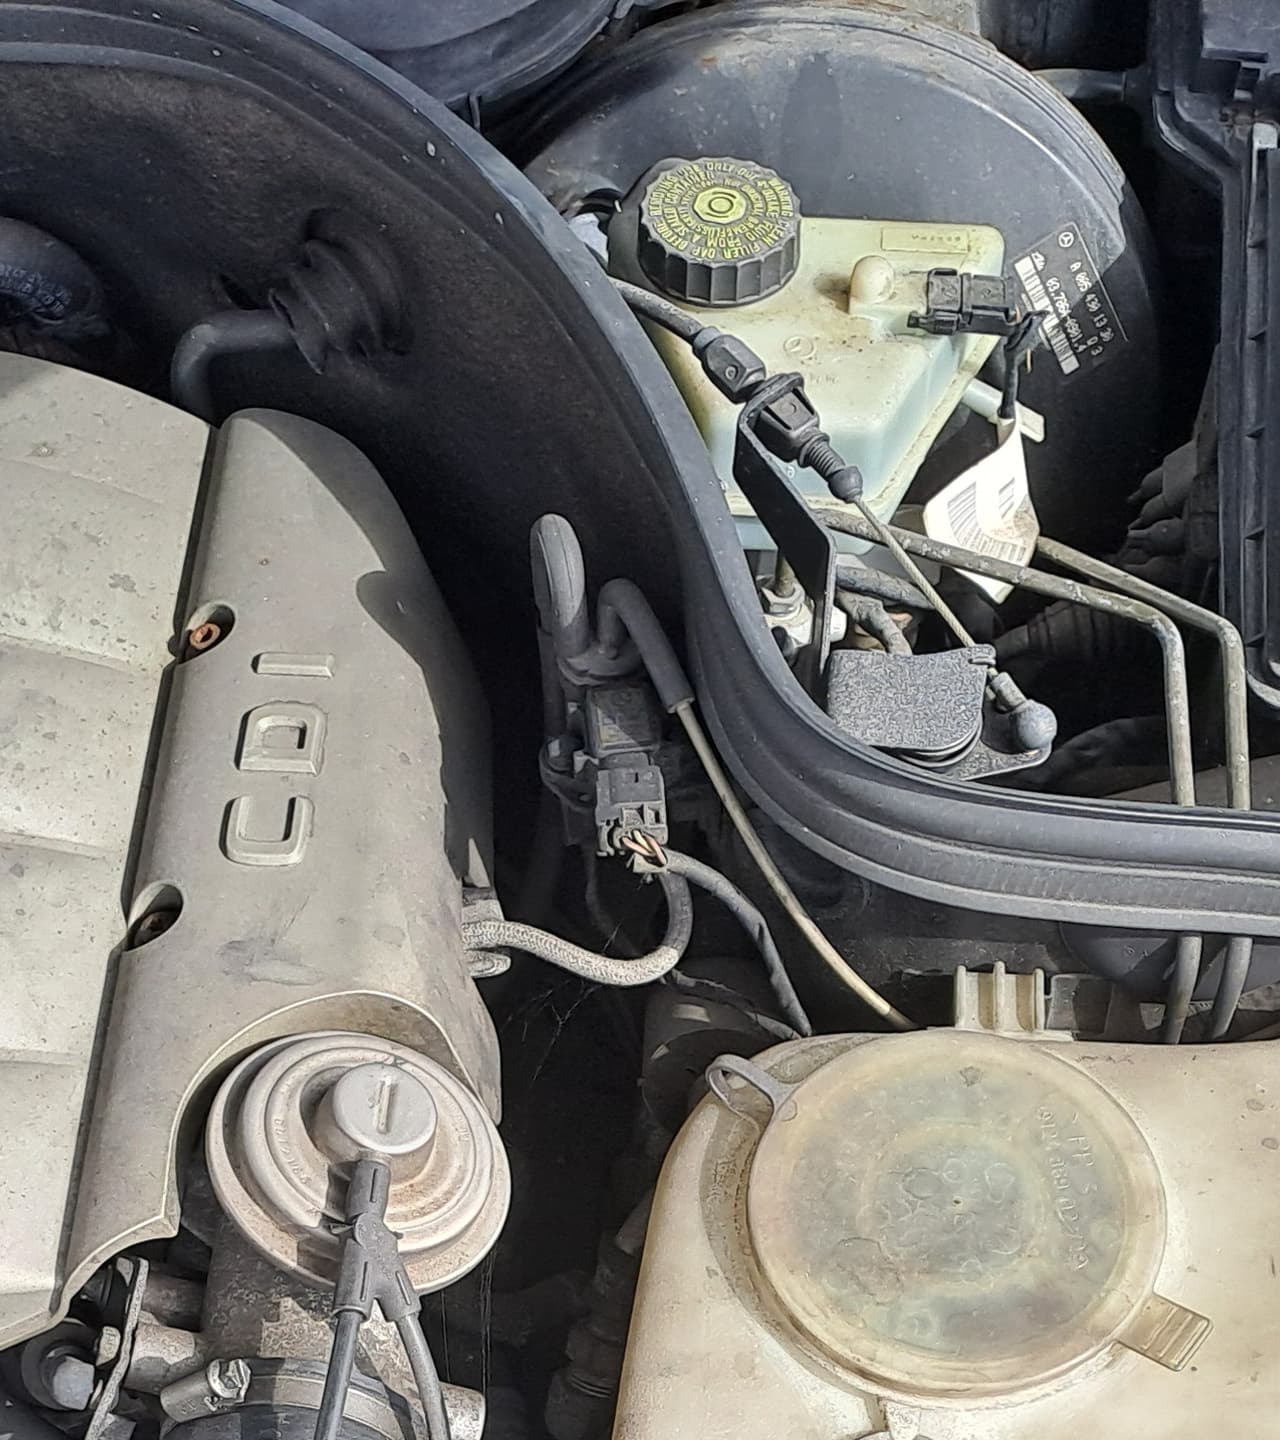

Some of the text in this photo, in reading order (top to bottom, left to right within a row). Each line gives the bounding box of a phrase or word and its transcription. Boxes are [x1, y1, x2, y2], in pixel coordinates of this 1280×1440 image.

[706, 235, 741, 248] FROM
[723, 241, 762, 259] FILLER
[220, 651, 336, 868] CDI
